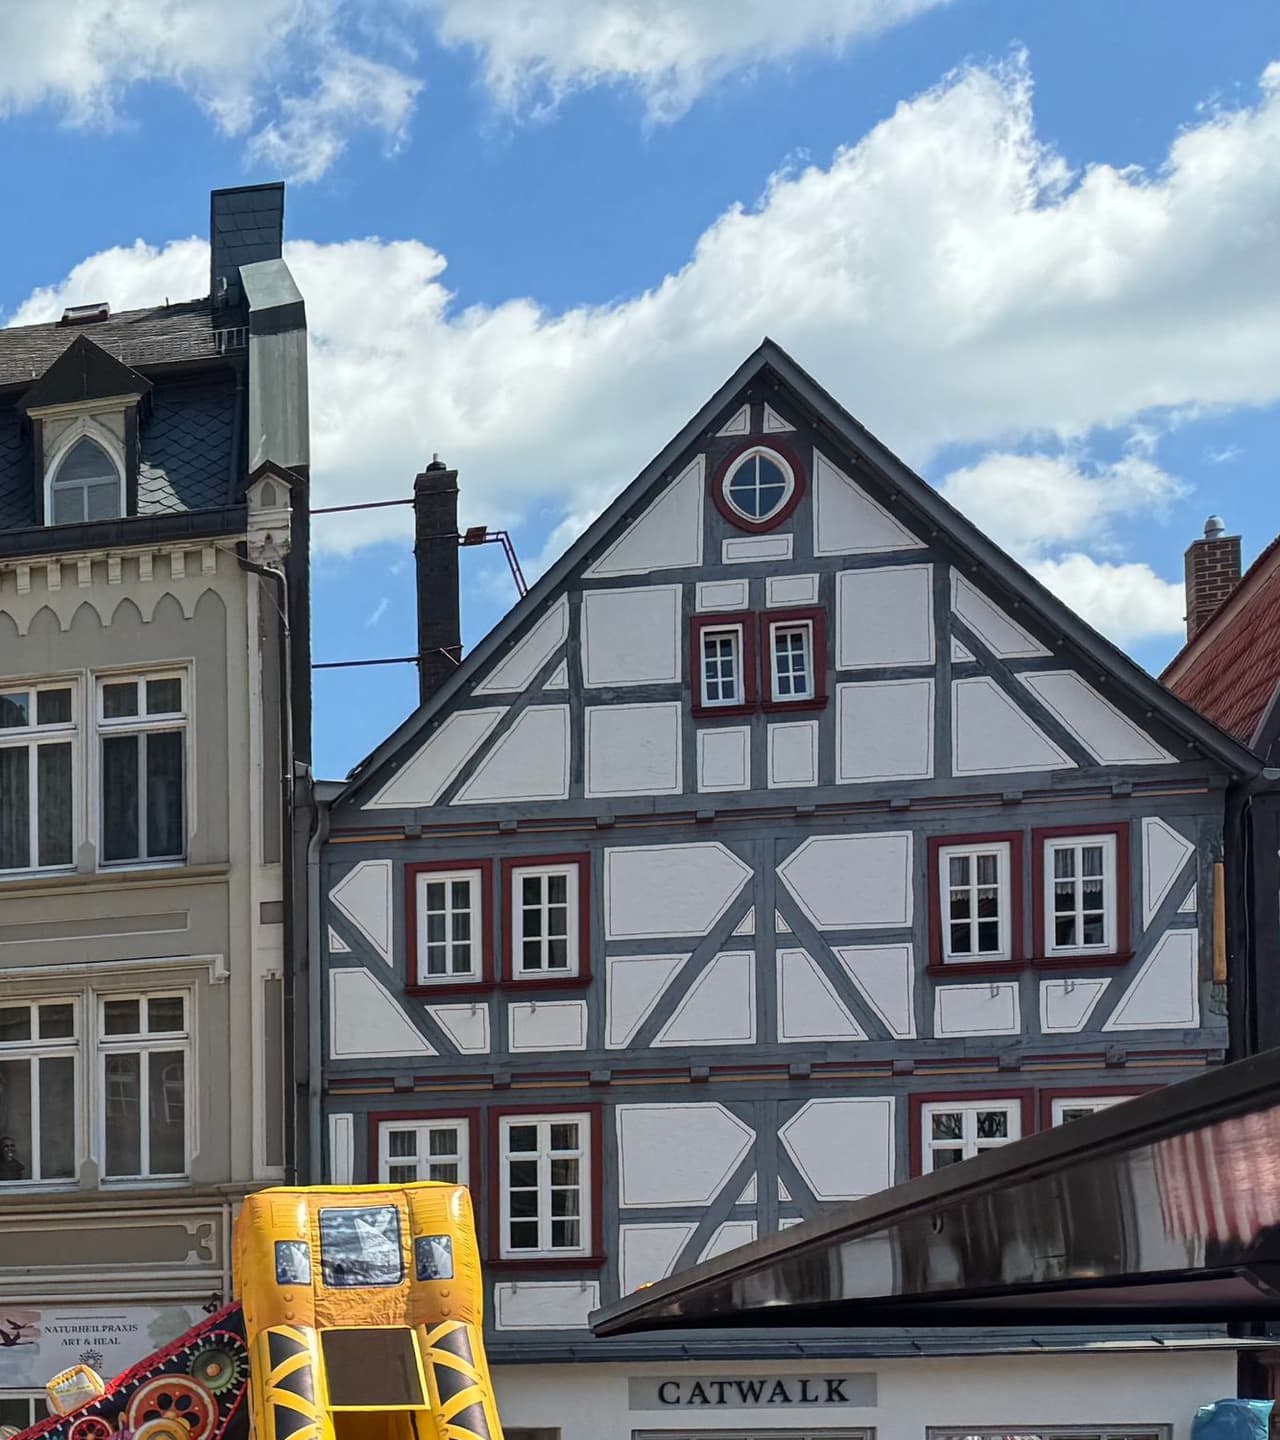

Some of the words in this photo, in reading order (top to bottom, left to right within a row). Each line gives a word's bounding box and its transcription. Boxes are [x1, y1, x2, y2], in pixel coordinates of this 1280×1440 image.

[44, 1324, 139, 1334] NATURHEILPRAXIS
[60, 1338, 82, 1347] ART
[83, 1338, 91, 1346] &
[93, 1337, 121, 1346] HEAL
[657, 1378, 850, 1405] CATWALK
